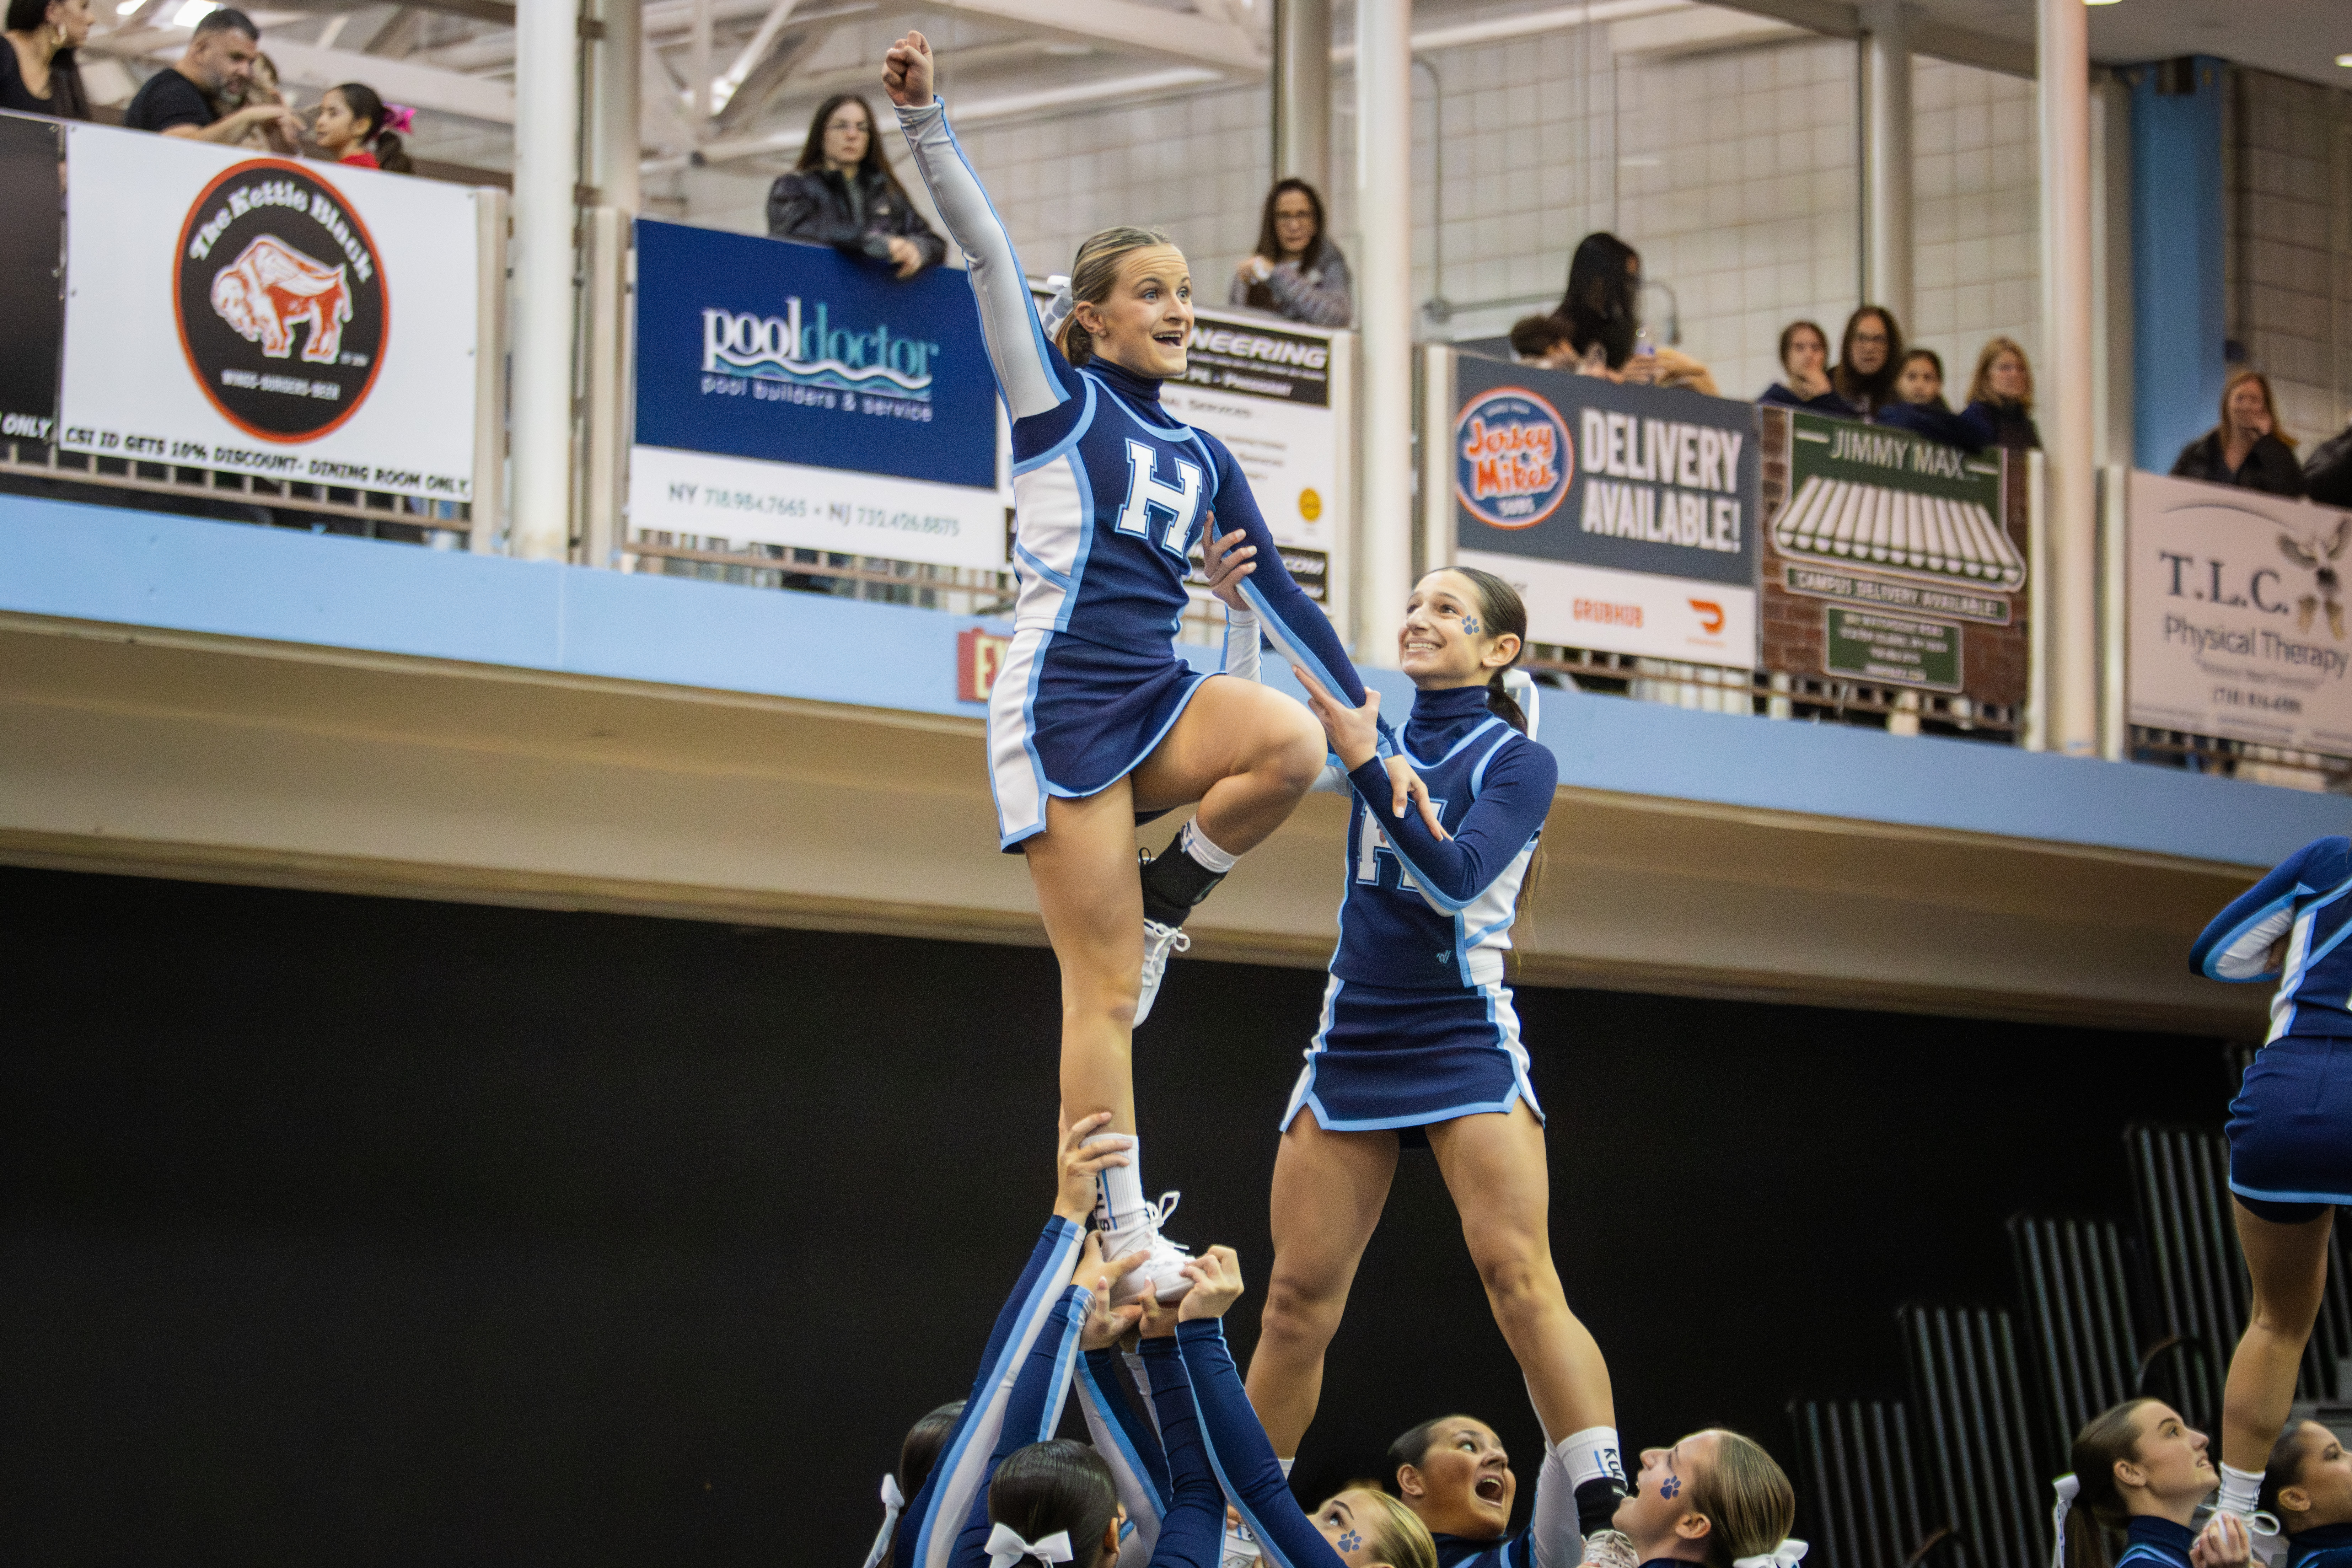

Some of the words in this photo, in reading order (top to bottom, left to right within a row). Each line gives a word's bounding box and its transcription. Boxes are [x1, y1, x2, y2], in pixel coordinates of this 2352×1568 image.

[188, 208, 233, 261] The
[227, 180, 309, 219] Kettle
[1188, 326, 1328, 370] NEERING
[701, 374, 747, 396] pool
[753, 380, 836, 409] builders
[842, 393, 856, 411] &
[863, 396, 932, 422] service
[65, 428, 94, 446] CSI
[100, 431, 119, 448] ID
[125, 435, 165, 455] GETS
[171, 441, 207, 460] 10%
[308, 460, 369, 481] DINING
[375, 468, 421, 488] ROOM
[1465, 418, 1554, 460] Jersey
[1581, 408, 1742, 493] DELIVERY
[1830, 429, 1908, 470] JIMMY
[1913, 442, 1965, 480] MAX
[669, 482, 699, 504] NY
[1115, 437, 1202, 559] H
[1581, 479, 1741, 553] AVAILABLE!
[1573, 597, 1643, 628] GRUBHUB
[1798, 572, 1851, 594] CAMPUS
[1857, 580, 1918, 603] DELIVERY
[2165, 612, 2256, 657] Physical
[2261, 629, 2349, 680] Therapy
